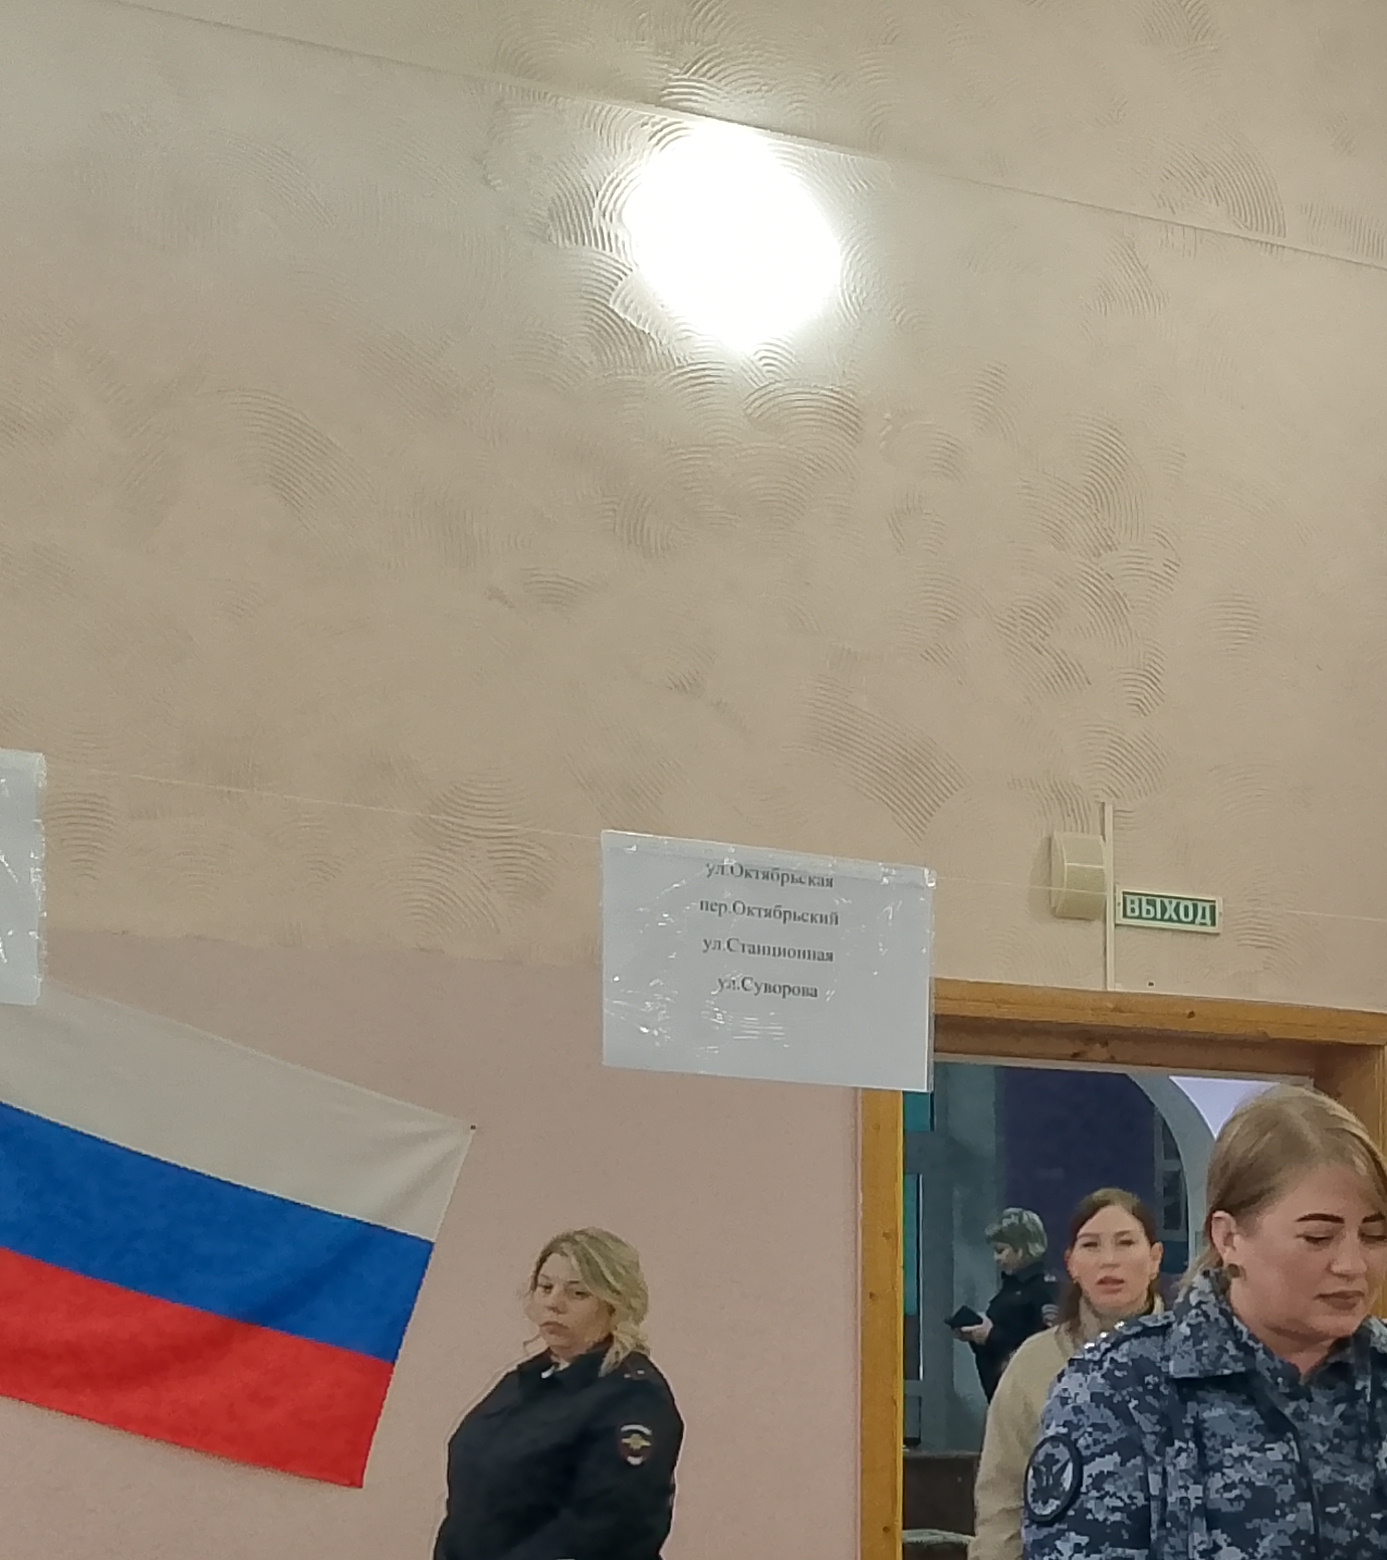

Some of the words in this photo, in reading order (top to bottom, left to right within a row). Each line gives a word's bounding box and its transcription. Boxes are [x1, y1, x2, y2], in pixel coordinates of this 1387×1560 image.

[706, 862, 834, 888] ул.Октябрьская
[700, 899, 839, 926] пер.Октябрьский
[1125, 895, 1211, 926] ВЫХОД
[702, 937, 834, 962] ул.Станционная
[718, 976, 818, 999] ул.Суворова
